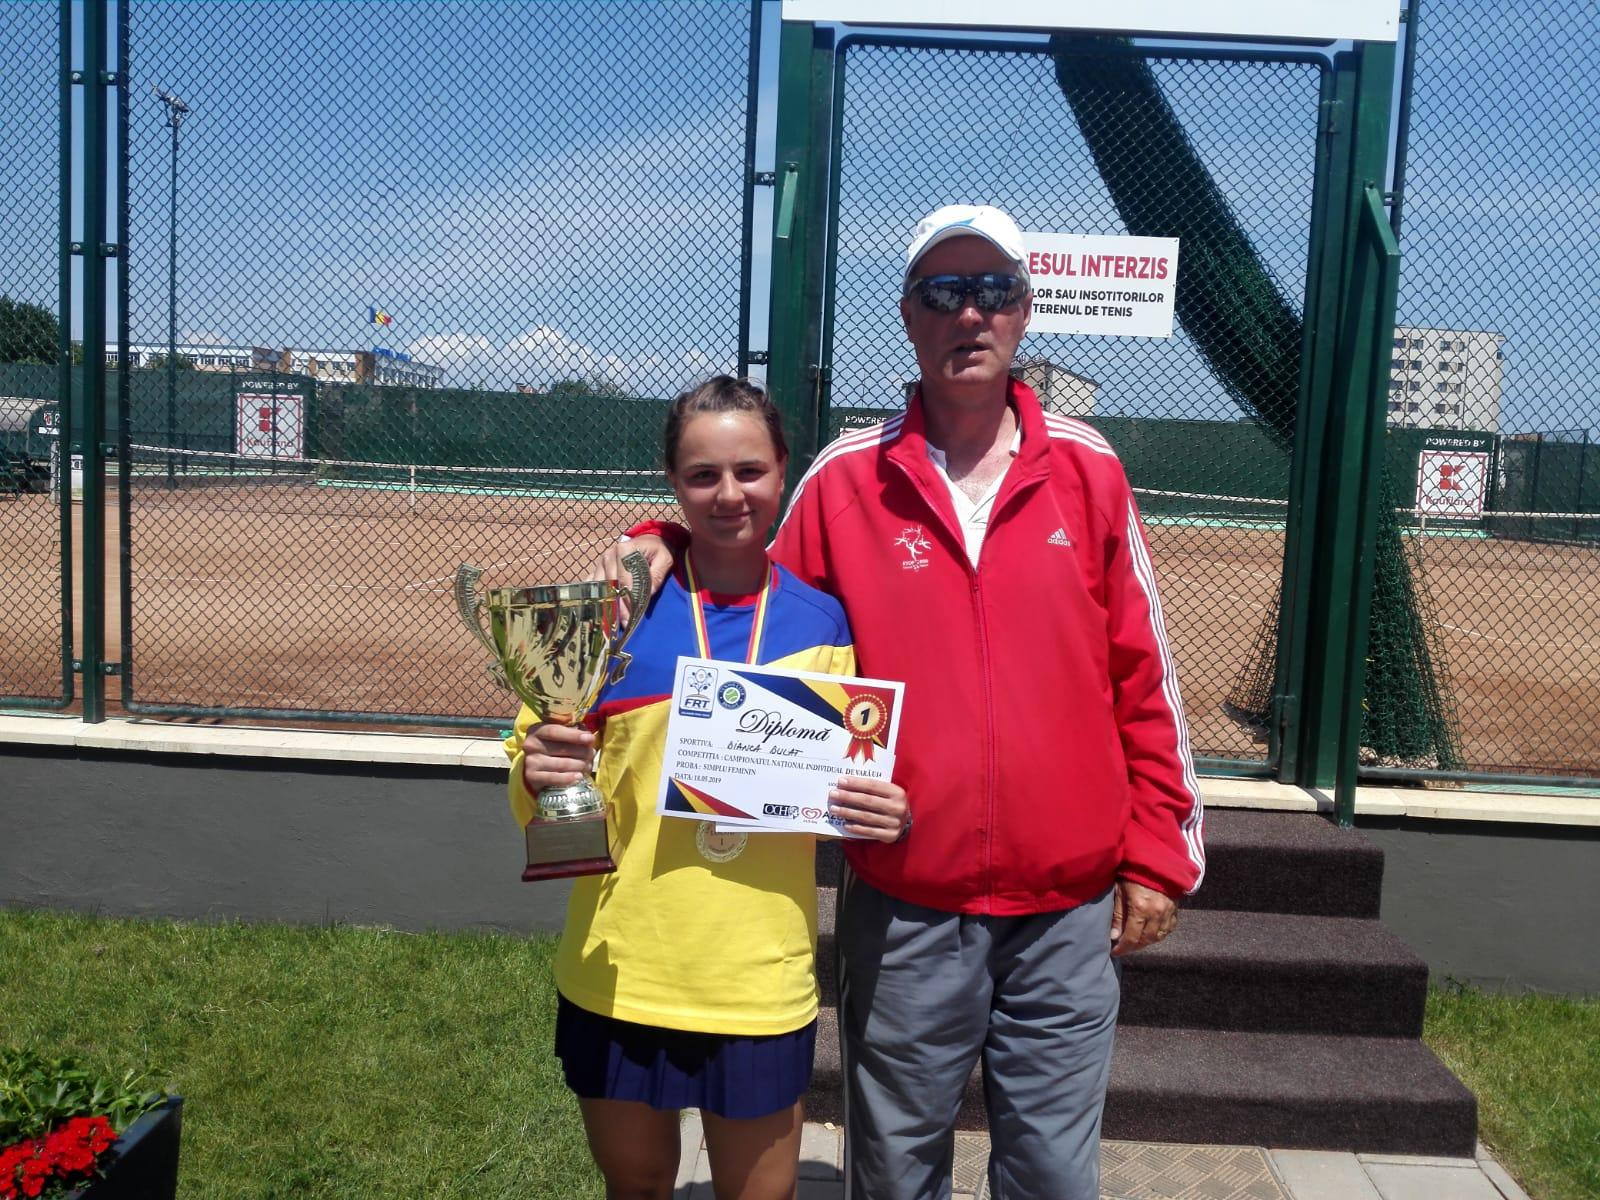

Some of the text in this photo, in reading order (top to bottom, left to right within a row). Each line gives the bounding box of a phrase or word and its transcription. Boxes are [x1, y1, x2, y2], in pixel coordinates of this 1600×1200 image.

[1029, 252, 1168, 280] ESUL INTERZIS
[1055, 289, 1077, 300] SAU
[1079, 290, 1164, 303] INSOTITORILOR
[1033, 303, 1133, 317] TERENUL DE TENIS
[287, 382, 299, 390] BY
[845, 415, 887, 424] POWERE
[246, 437, 293, 448] Kaufand
[1425, 438, 1485, 448] POWERED BY
[1425, 496, 1474, 506] Kaufland
[1047, 538, 1071, 547] adidas
[685, 698, 711, 708] FRT
[860, 708, 871, 726] 1
[727, 741, 761, 752] BIANCA
[703, 763, 728, 772] SIMPLU
[728, 766, 756, 775] FEMININ
[724, 754, 769, 766] CAMPIONATUL
[805, 763, 843, 774] INDIVIDUAL
[845, 768, 855, 776] DE
